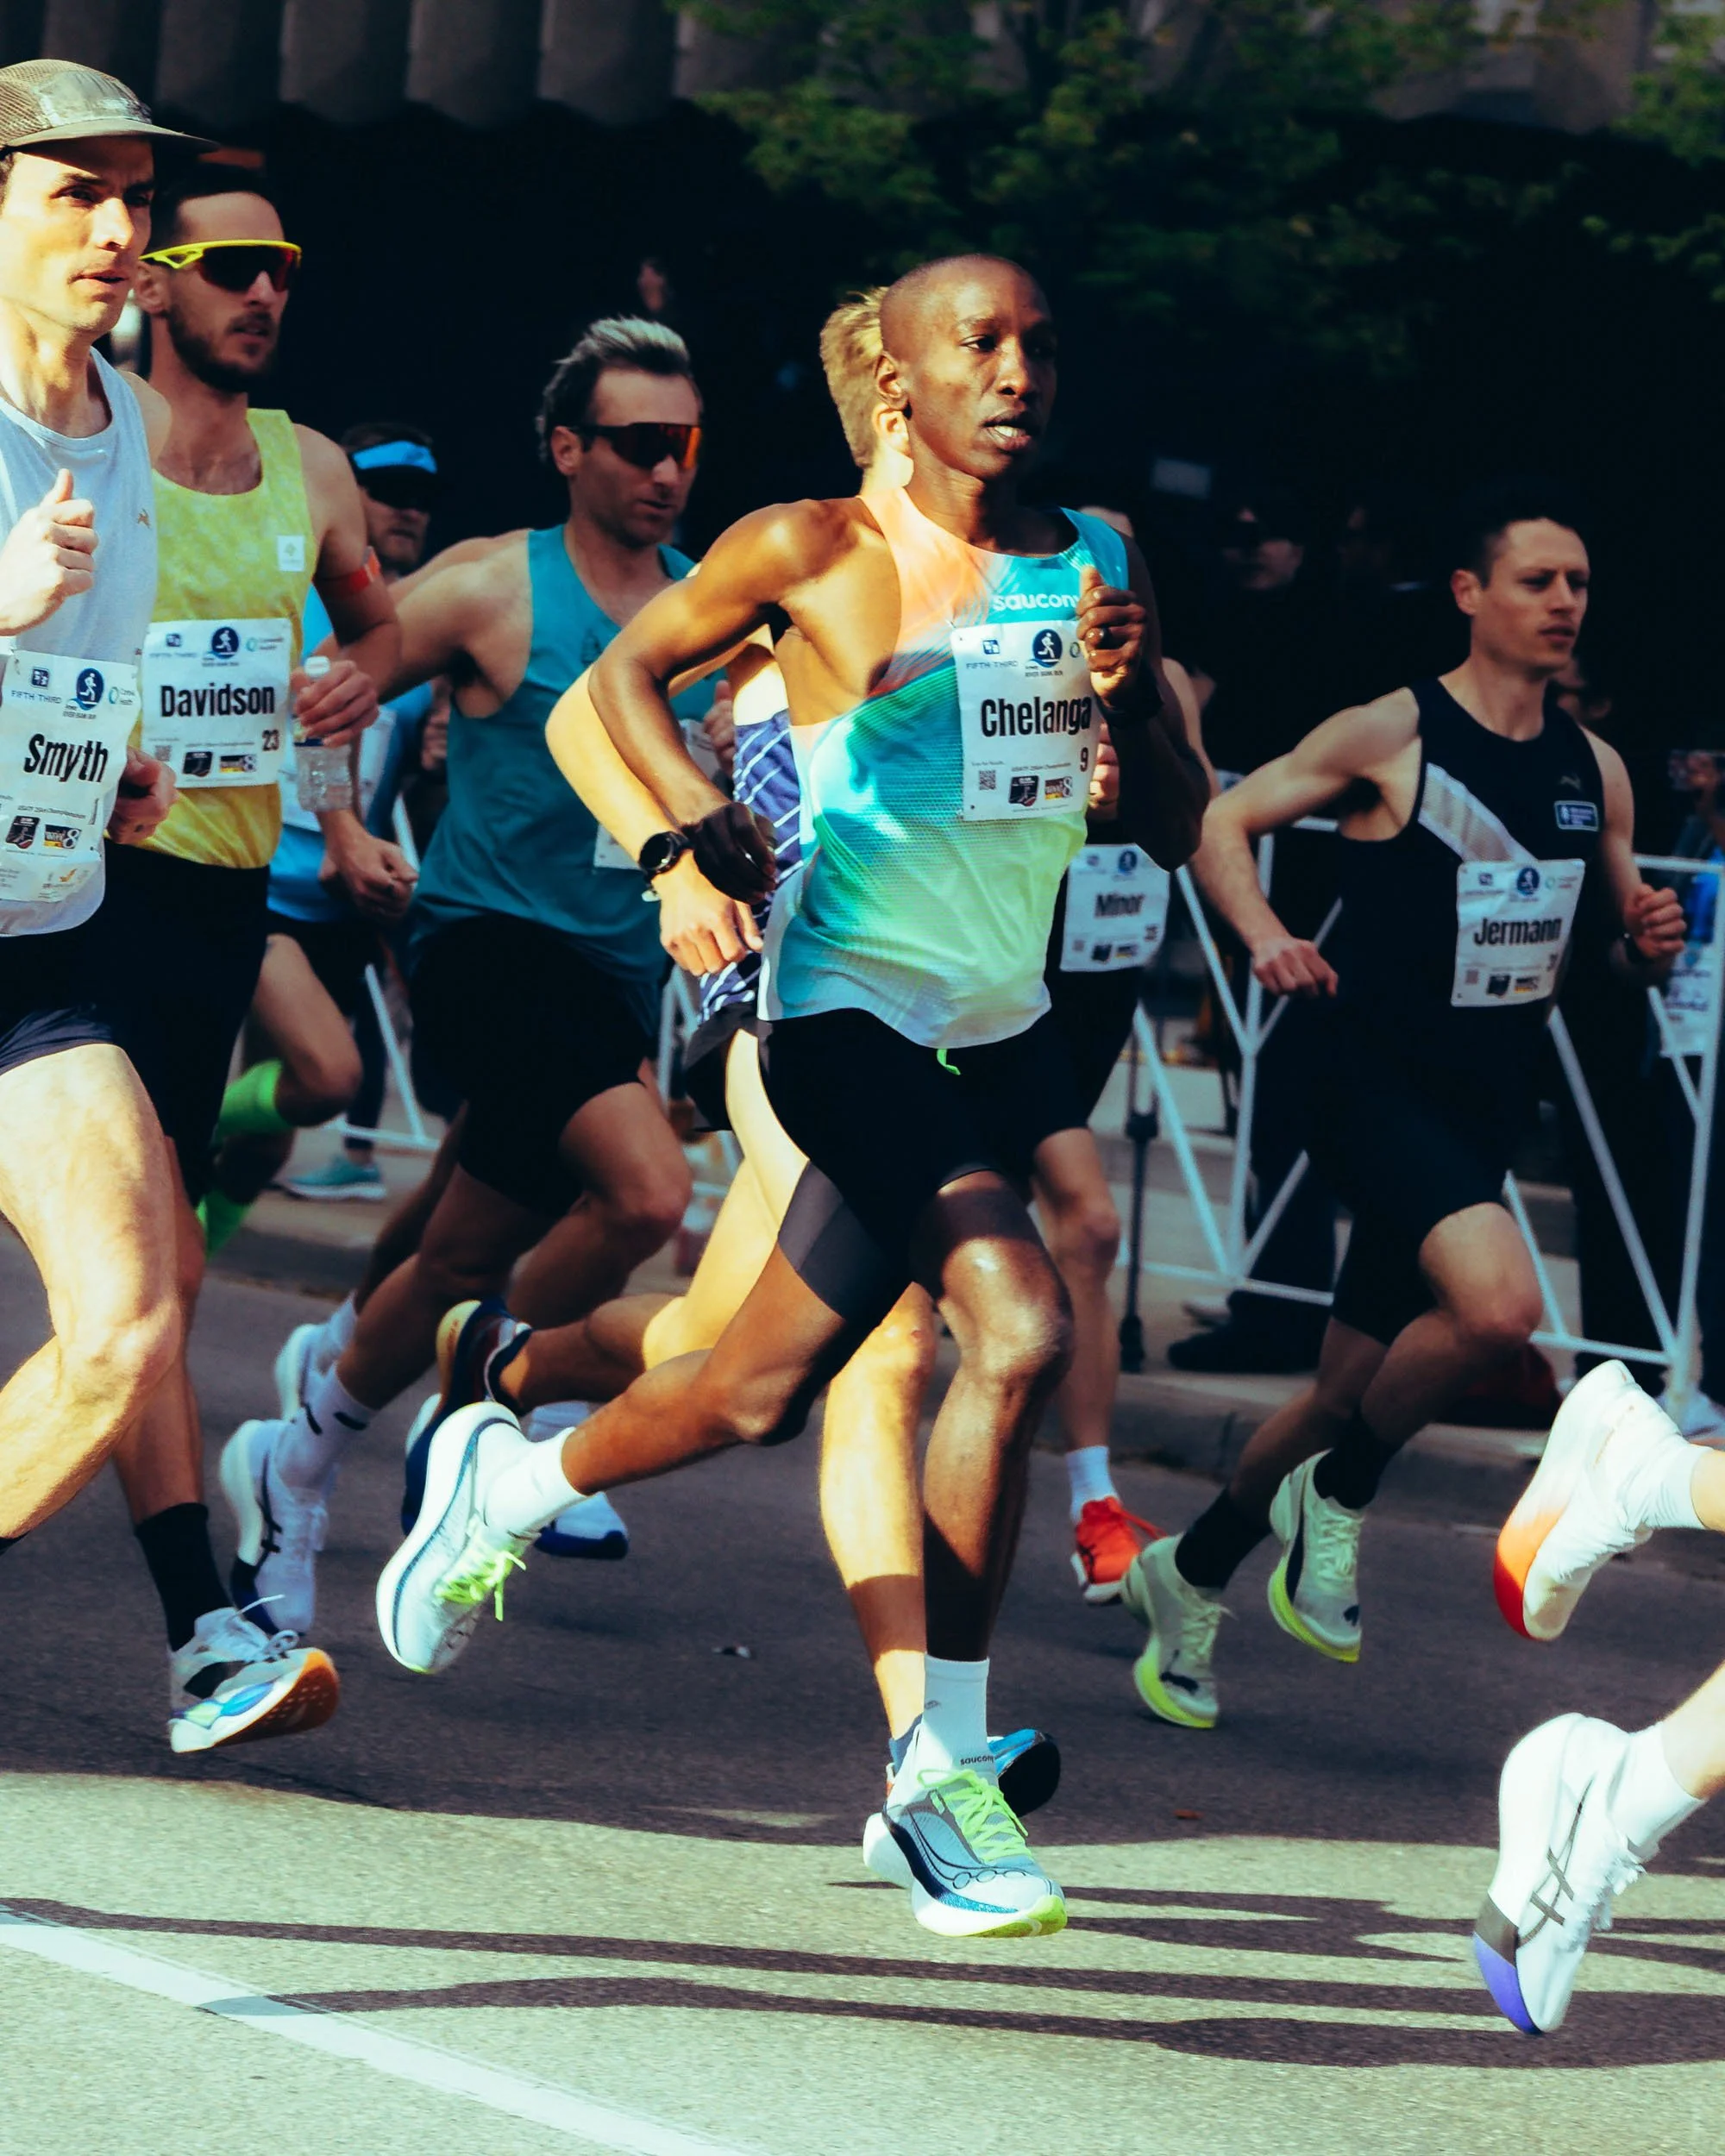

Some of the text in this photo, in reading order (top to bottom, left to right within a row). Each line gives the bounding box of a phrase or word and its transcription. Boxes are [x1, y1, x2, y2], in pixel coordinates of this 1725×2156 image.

[11, 690, 62, 704] FIFTH THIRD
[160, 681, 275, 717] Davidson
[981, 696, 1093, 737] Chelanga
[261, 729, 279, 751] 23
[23, 733, 109, 783] Smyth
[1079, 747, 1088, 772] 9
[1474, 918, 1563, 946] Jermann
